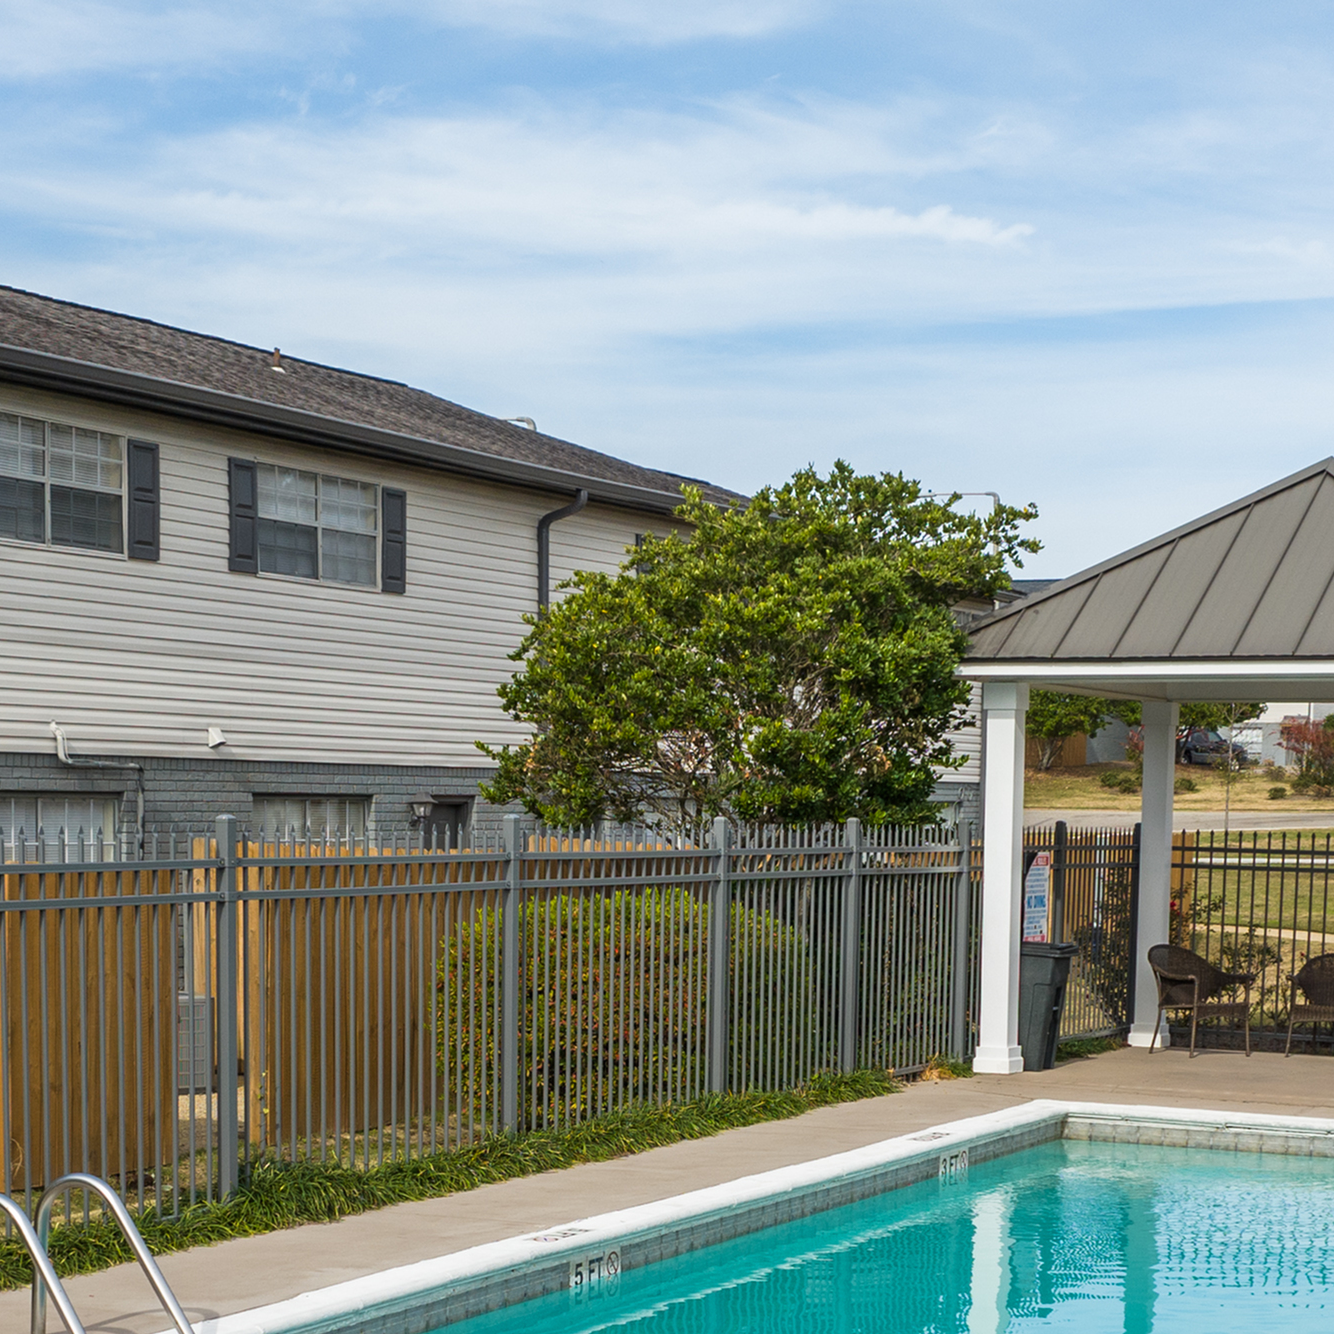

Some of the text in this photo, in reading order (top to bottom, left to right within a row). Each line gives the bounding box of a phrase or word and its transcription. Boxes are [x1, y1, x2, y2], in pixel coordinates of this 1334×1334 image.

[941, 1158, 947, 1174] 3
[574, 1257, 604, 1286] 5 FT
